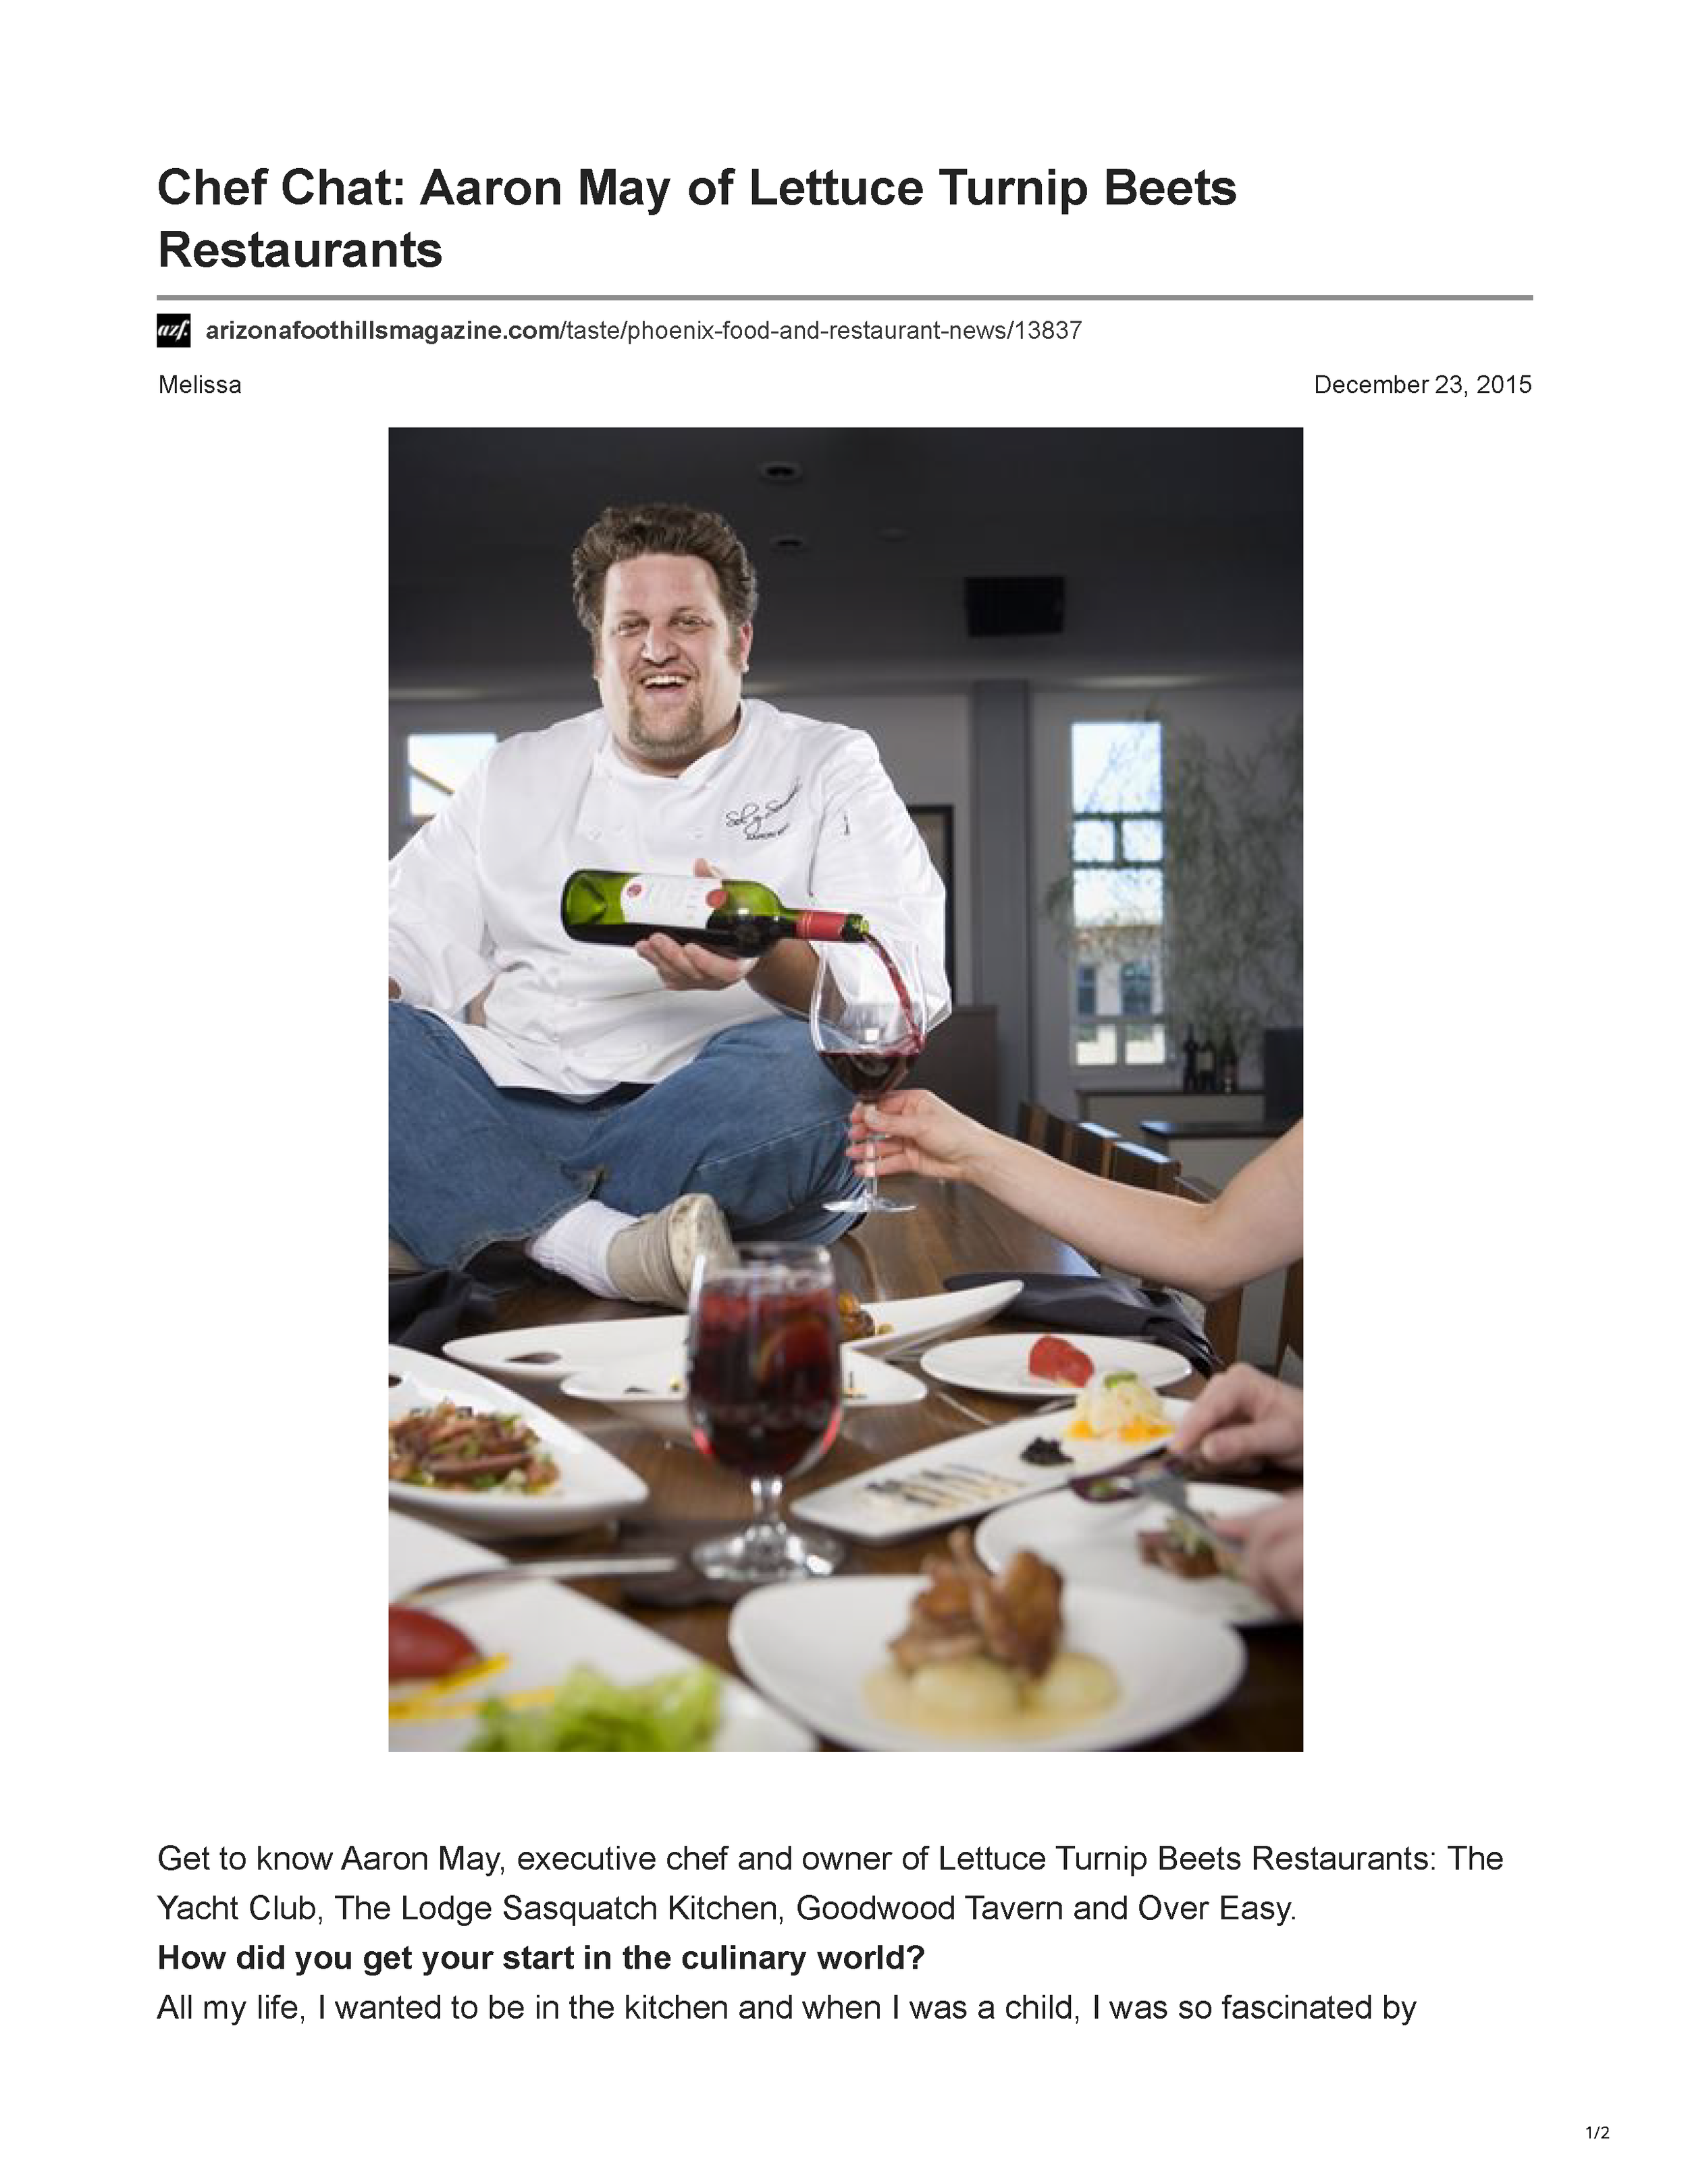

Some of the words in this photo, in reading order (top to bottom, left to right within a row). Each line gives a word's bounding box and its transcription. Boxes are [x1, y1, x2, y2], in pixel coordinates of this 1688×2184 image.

[159, 168, 269, 205] Chef
[283, 168, 402, 205] Chat:
[420, 169, 560, 205] Aaron
[581, 169, 670, 215] May
[689, 168, 735, 205] of
[752, 169, 923, 205] Lettuce
[939, 169, 1087, 215] Turnip
[1107, 169, 1236, 205] Beets
[161, 231, 442, 267] Restaurants
[207, 321, 1082, 344] arizonafoothillsmagazine.com/taste/phoenix-food-and-restaurant-news/13837
[160, 375, 241, 393] Melissa
[1316, 375, 1429, 393] December
[1435, 375, 1467, 397] 23,
[1477, 375, 1531, 393] 2015
[159, 1845, 210, 1871] Get
[219, 1846, 246, 1870] to
[258, 1846, 333, 1870] know
[341, 1846, 427, 1870] Aaron
[440, 1846, 504, 1876] May,
[519, 1846, 656, 1870] executive
[667, 1846, 729, 1870] chef
[739, 1846, 791, 1870] and
[803, 1852, 893, 1870] owner
[903, 1846, 930, 1870] of
[941, 1846, 1045, 1870] Lettuce
[1056, 1846, 1146, 1876] Turnip
[1160, 1846, 1240, 1870] Beets
[1254, 1846, 1435, 1870] Restaurants:
[1448, 1846, 1503, 1870] The
[157, 1896, 238, 1919] Yacht
[250, 1895, 322, 1925] Club,
[335, 1896, 390, 1919] The
[403, 1896, 492, 1926] Lodge
[504, 1895, 656, 1926] Sasquatch
[670, 1896, 783, 1925] Kitchen,
[797, 1895, 954, 1920] Goodwood
[965, 1896, 1062, 1919] Tavern
[1074, 1896, 1127, 1919] and
[1139, 1895, 1209, 1920] Over
[1221, 1896, 1295, 1926] Easy.
[159, 1945, 226, 1969] How
[237, 1945, 284, 1969] did
[295, 1951, 351, 1975] you
[364, 1946, 412, 1975] get
[422, 1951, 494, 1975] your
[503, 1946, 574, 1969] start
[585, 1945, 610, 1969] in
[623, 1945, 670, 1969] the
[683, 1945, 806, 1975] culinary
[817, 1945, 924, 1969] world?
[157, 1995, 191, 2019] All
[205, 2000, 246, 2025] my
[259, 1995, 304, 2024] life,
[335, 1995, 440, 2019] wanted
[452, 1996, 477, 2019] to
[490, 1995, 524, 2019] be
[537, 1995, 558, 2019] in
[569, 1995, 614, 2019] the
[626, 1995, 727, 2019] kitchen
[739, 1995, 792, 2019] and
[802, 1995, 880, 2019] when
[909, 2000, 966, 2019] was
[978, 2000, 995, 2019] a
[1006, 1995, 1078, 2024] child,
[1109, 2000, 1167, 2019] was
[1179, 2000, 1211, 2019] so
[1222, 1995, 1371, 2019] fascinated
[1384, 1995, 1417, 2025] by
[1585, 2126, 1610, 2139] 1/2
